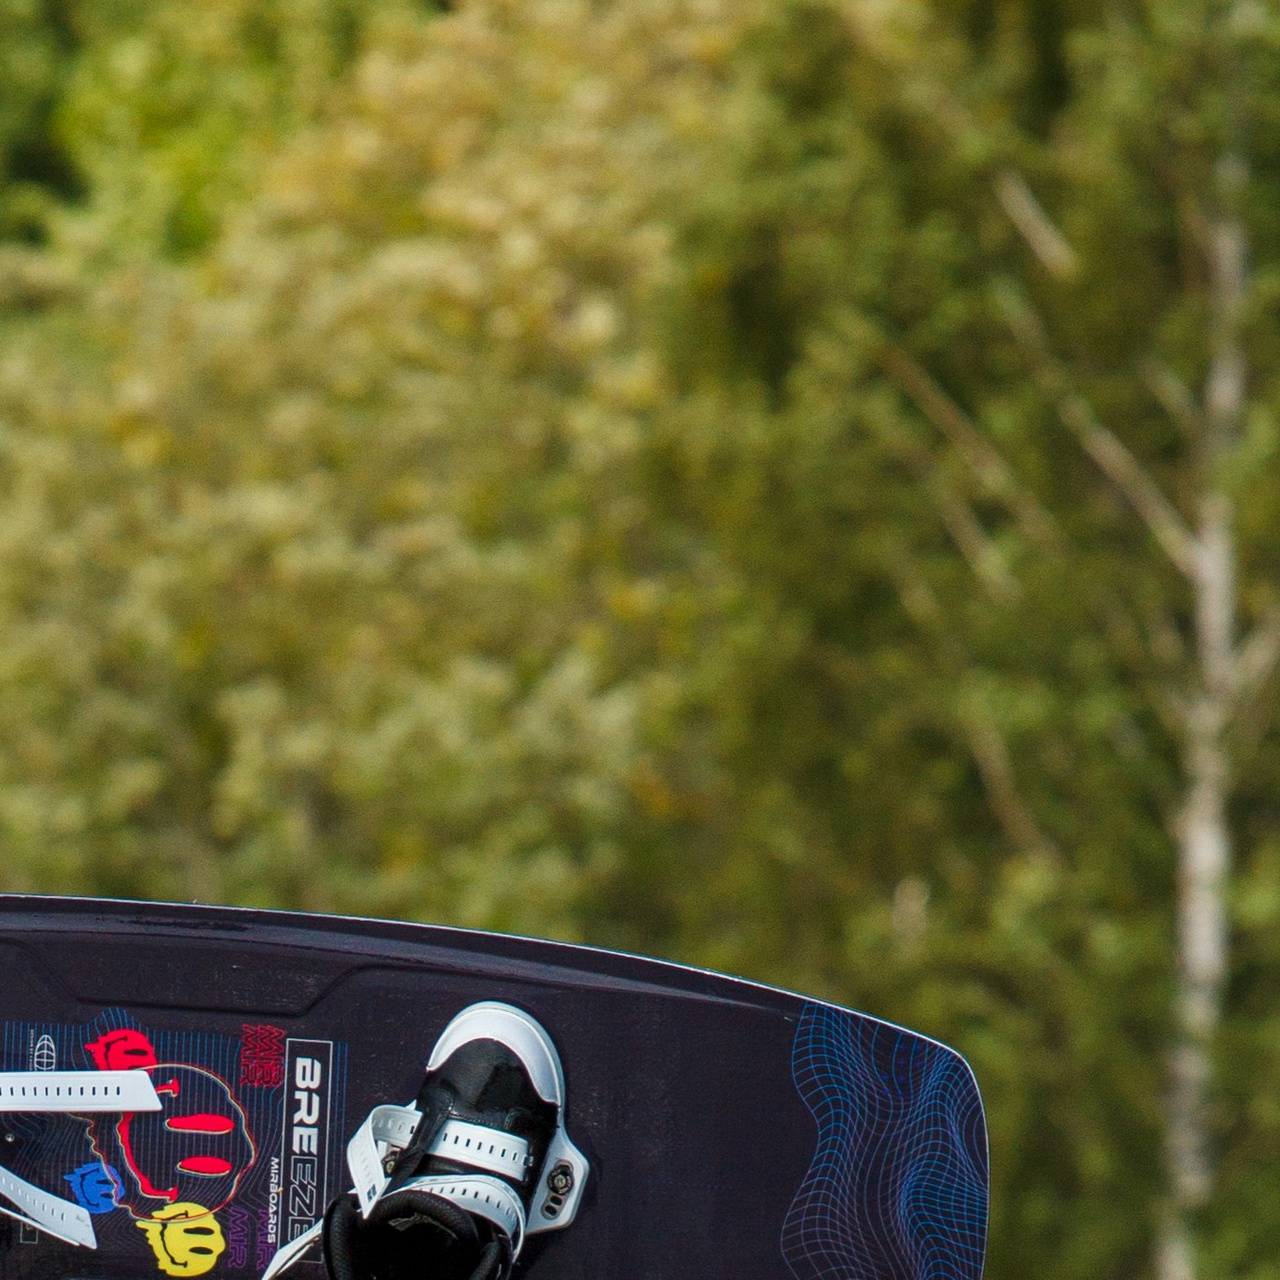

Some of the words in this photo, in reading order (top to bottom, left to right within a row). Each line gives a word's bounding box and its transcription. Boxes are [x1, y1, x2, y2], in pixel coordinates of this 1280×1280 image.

[287, 1056, 322, 1243] BREEZE
[227, 1206, 250, 1269] MIR
[267, 1156, 280, 1244] MIRBOARDS
